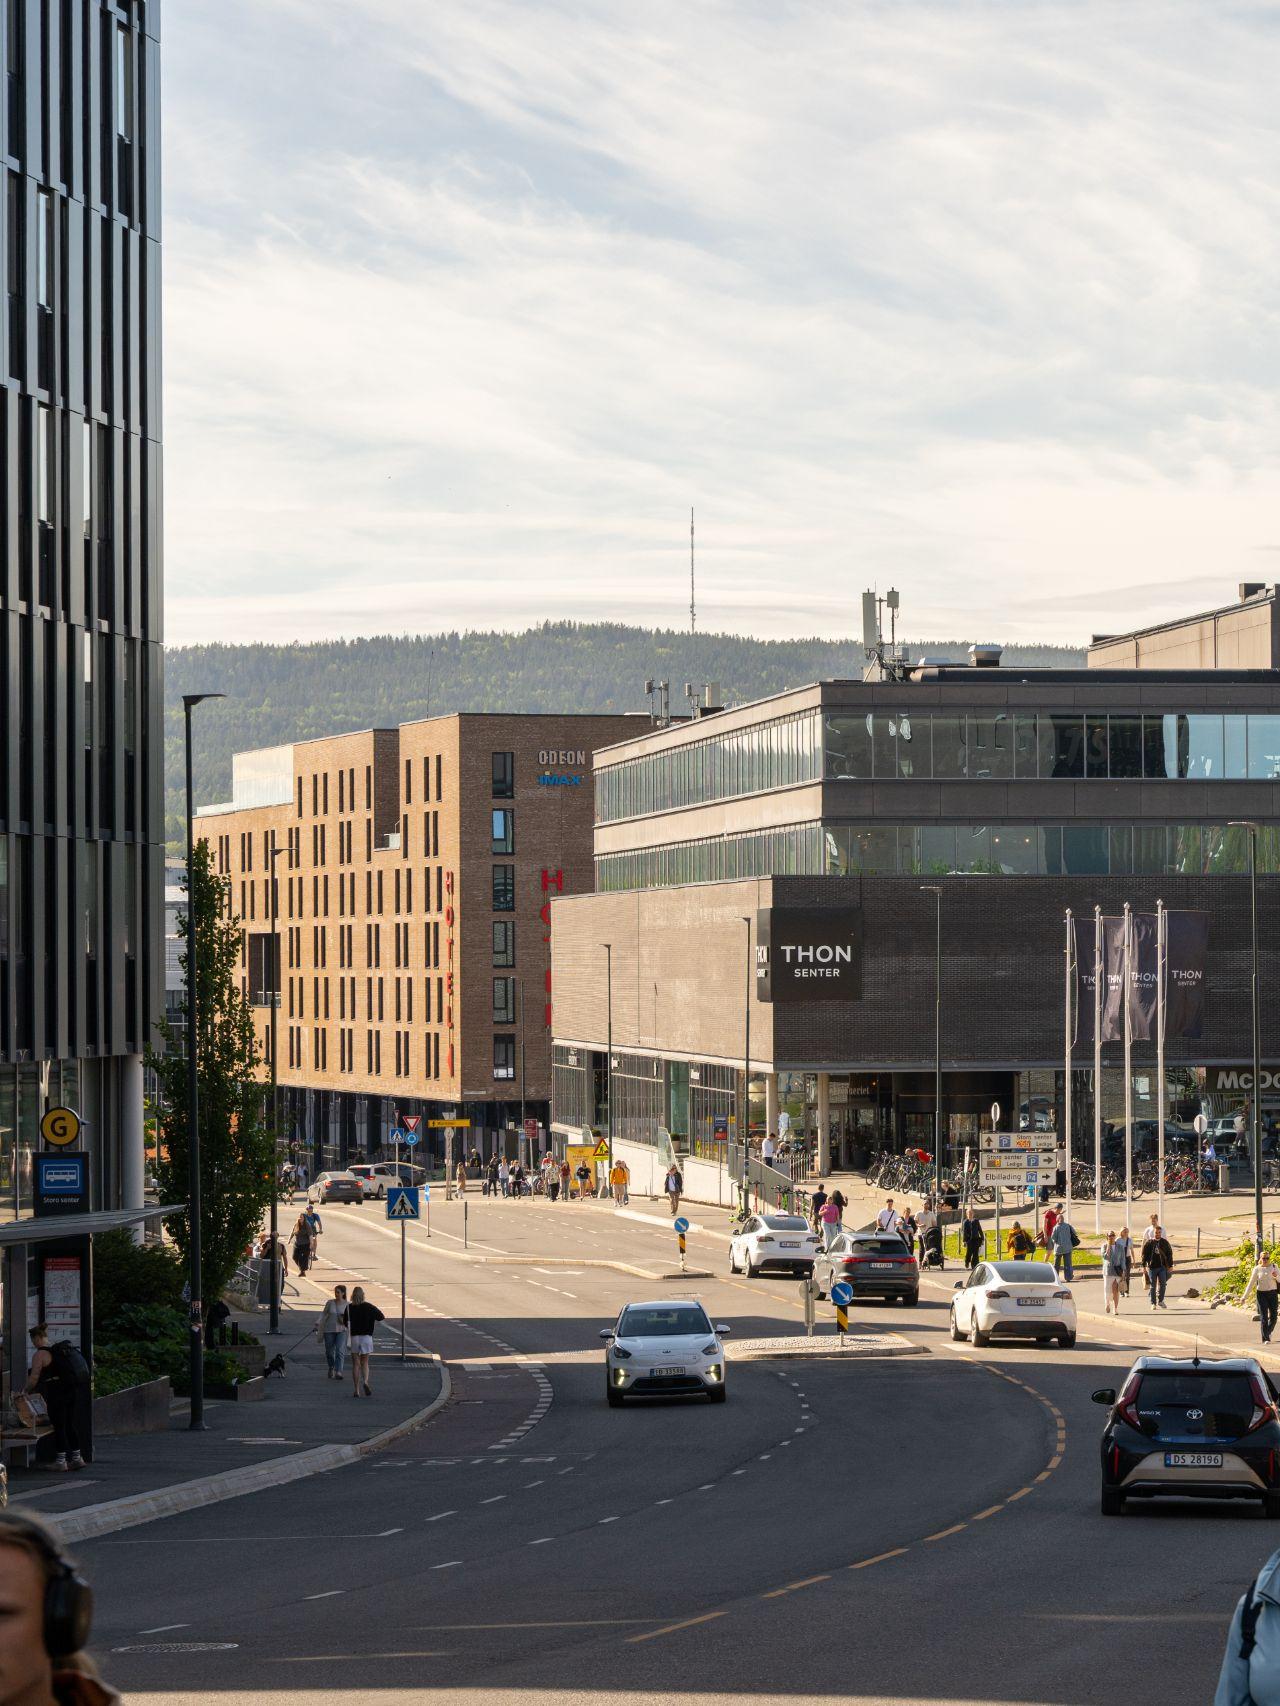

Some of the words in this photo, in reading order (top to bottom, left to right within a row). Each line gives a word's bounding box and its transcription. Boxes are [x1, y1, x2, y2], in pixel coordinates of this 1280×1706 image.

[538, 750, 586, 765] ODEON
[538, 773, 581, 786] IMAX
[781, 945, 851, 963] THON
[794, 968, 840, 978] SENTER
[1131, 972, 1158, 982] THON
[1172, 970, 1203, 980] THON
[51, 1116, 68, 1137] G
[985, 1173, 1022, 1182] Elbillading
[1174, 1455, 1186, 1464] DS
[1190, 1455, 1219, 1464] 28196
